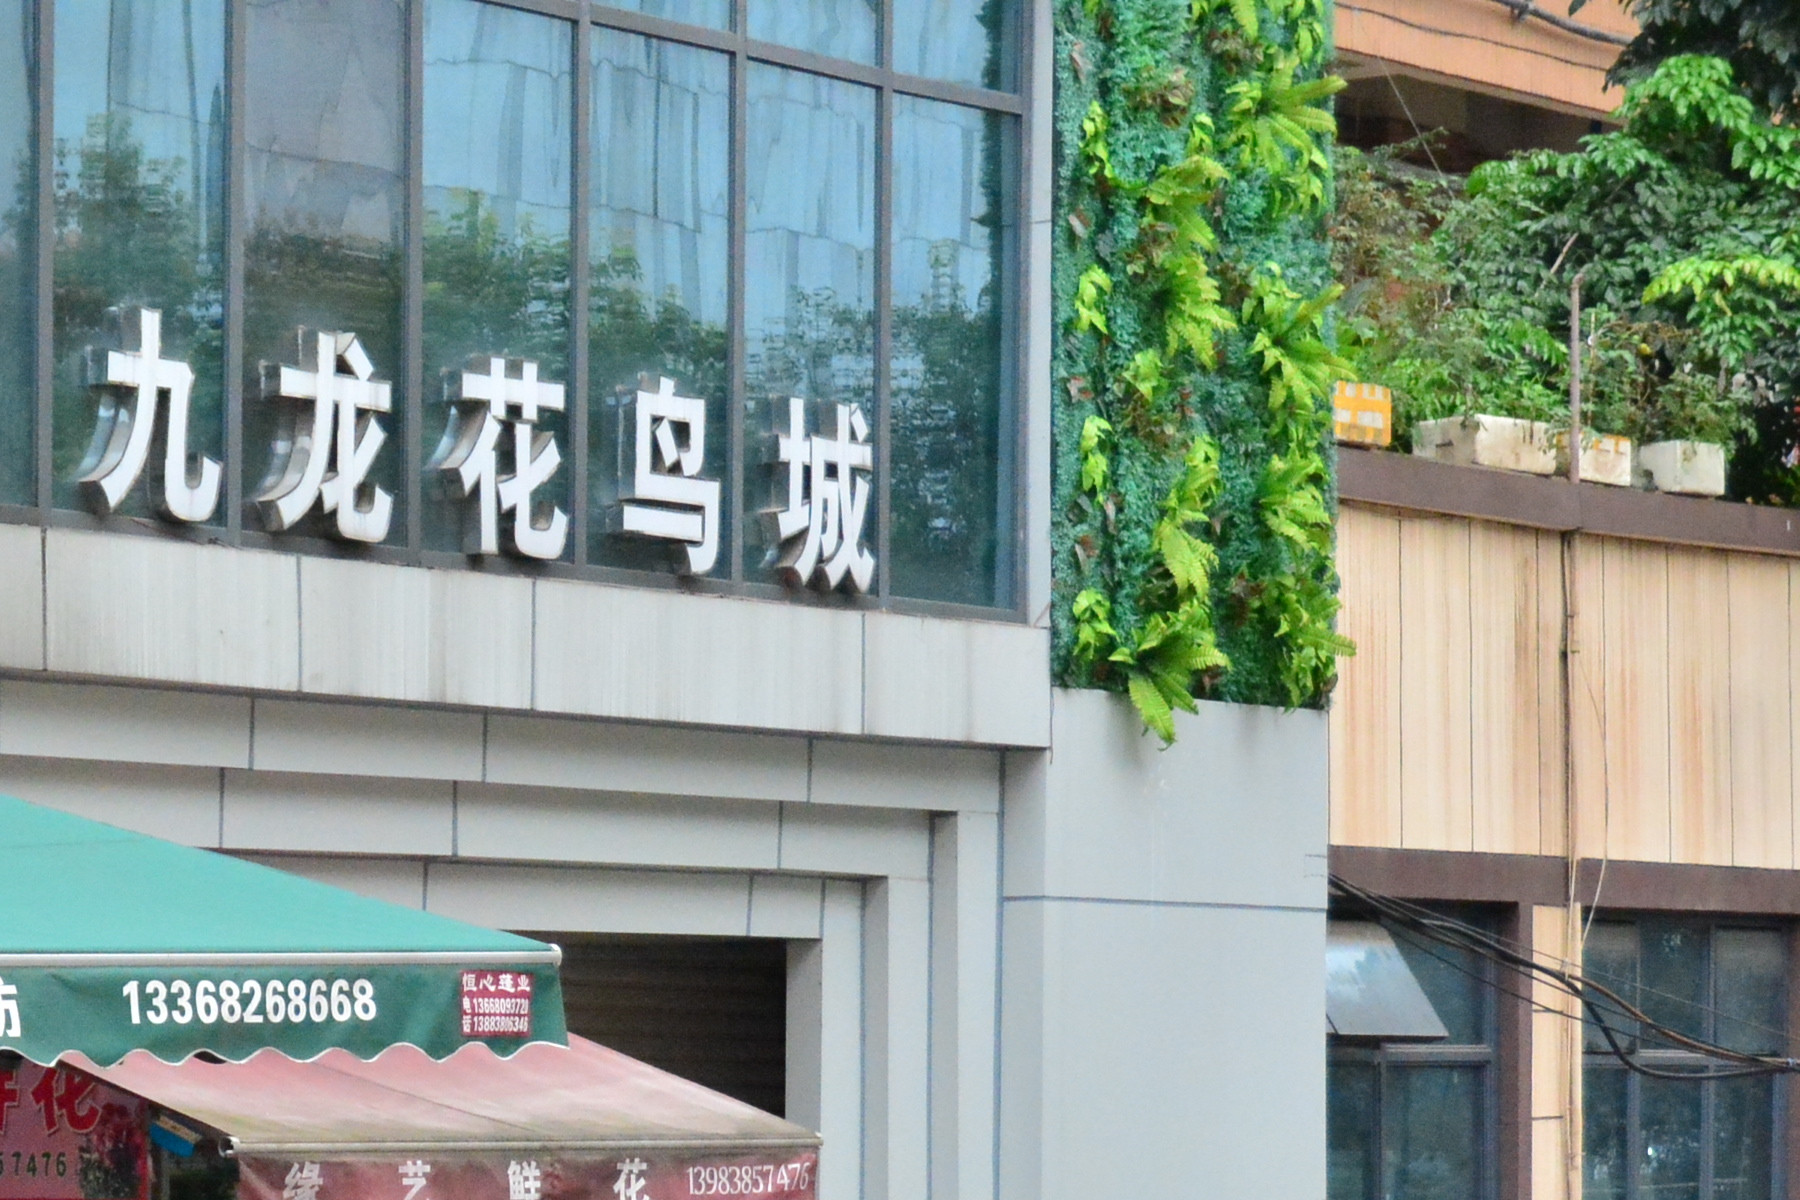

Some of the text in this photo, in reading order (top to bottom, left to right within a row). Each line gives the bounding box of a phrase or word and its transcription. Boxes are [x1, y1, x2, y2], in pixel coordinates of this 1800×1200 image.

[80, 307, 874, 594] 九龙花鸟城
[122, 978, 377, 1024] 13368268668
[687, 1162, 811, 1195] 13983857476
